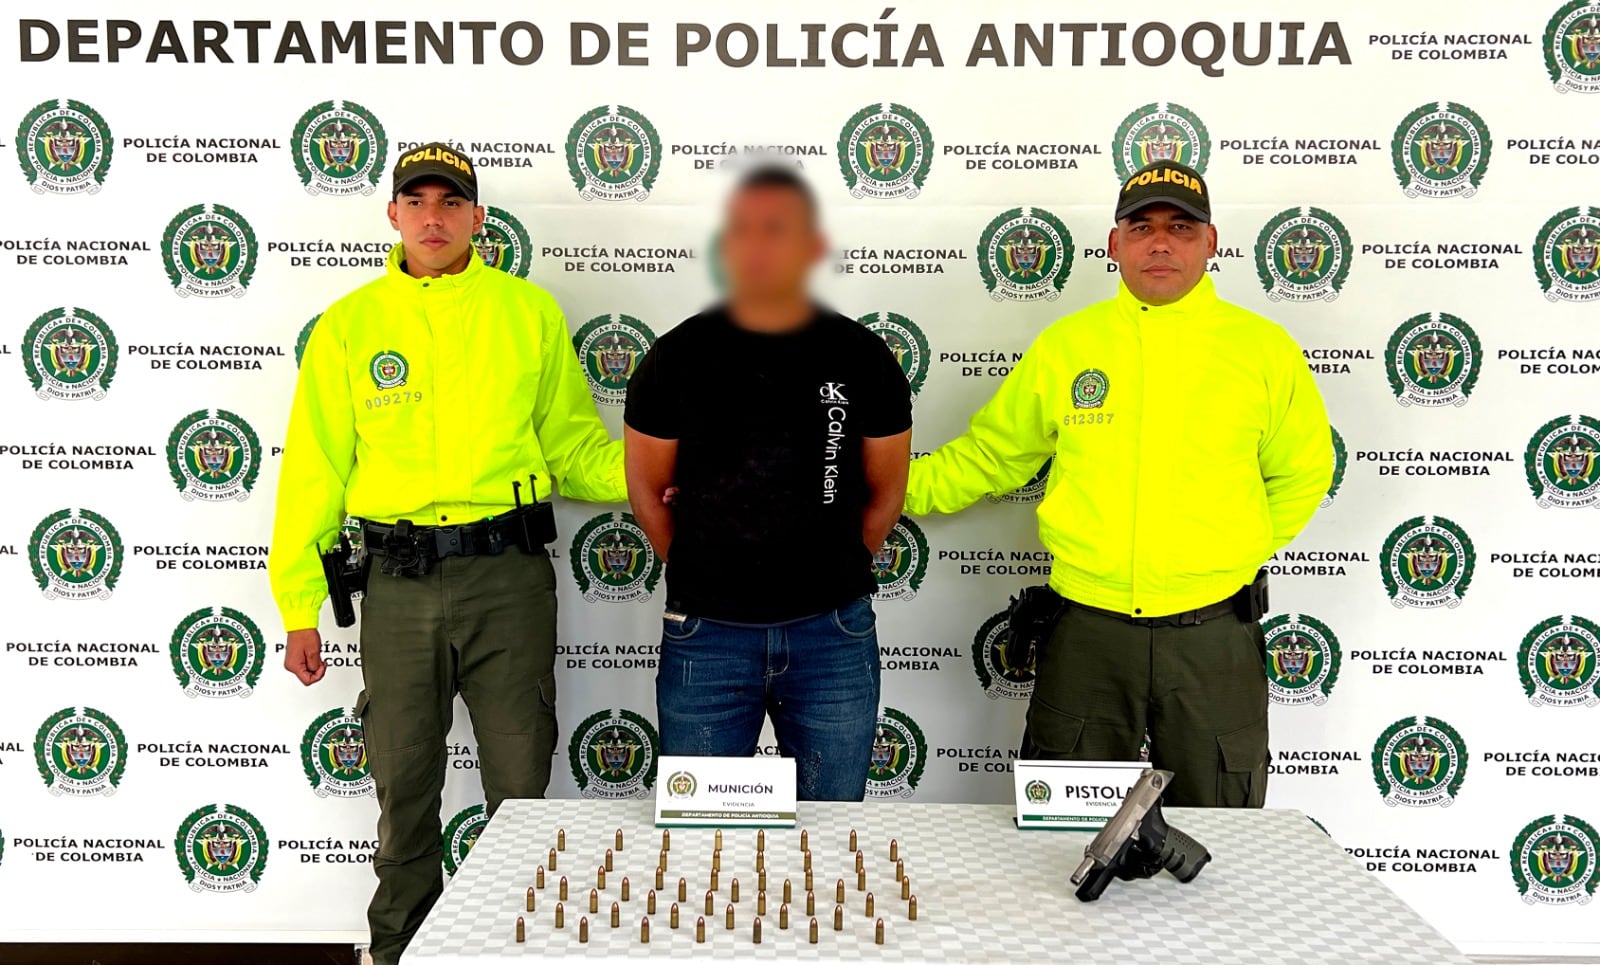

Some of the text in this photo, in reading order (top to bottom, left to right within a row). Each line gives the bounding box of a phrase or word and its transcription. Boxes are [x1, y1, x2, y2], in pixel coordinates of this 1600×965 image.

[20, 8, 1351, 77] DEPARTAMENTO DE POLICÍA ANTIOQUIA
[1369, 32, 1532, 45] POLICÍA NACIONAL
[1392, 49, 1507, 60] DE COLOMBIA
[77, 114, 101, 153] COLOMBIA
[124, 135, 280, 148] POLICÍA NACIONAL
[1221, 137, 1381, 150] POLICÍA NACIONAL
[1507, 136, 1575, 149] POLICÍA
[471, 143, 556, 154] NACIONAL
[672, 142, 736, 155] POLICÍA
[944, 142, 1101, 155] POLICÍA NACIONAL
[147, 153, 258, 163] DE COLOMBIA
[474, 157, 533, 167] LOMBIA
[1243, 155, 1357, 164] DE COLOMBIA
[1530, 154, 1599, 164] DE COLO
[695, 160, 714, 169] DE
[966, 159, 1078, 169] DE COLOMBIA
[66, 161, 98, 183] NACIONAL
[41, 181, 60, 192] DIOS
[66, 181, 91, 192] PATRIA
[67, 241, 150, 251] NACIONAL
[268, 240, 393, 253] POLICÍA NACIO
[1362, 241, 1522, 254] POLICÍA NACIONAL
[542, 245, 697, 258] POLICÍA NACIONAL
[884, 249, 967, 259] NACIONAL
[17, 255, 128, 265] DE COLOMBIA
[291, 257, 386, 267] DE COLOMB
[1385, 259, 1499, 268] DE COLOMBIA
[565, 262, 675, 272] DE COLOMBIA
[860, 264, 944, 273] COLOMBIA
[129, 343, 285, 356] POLICÍA NACIONAL
[1448, 327, 1470, 366] COLOMBIA
[940, 350, 1006, 362] POLICÍA
[1302, 350, 1374, 359] ACIONAL
[1498, 347, 1566, 359] POLICÍA
[151, 360, 262, 370] DE COLOMBIA
[1521, 364, 1600, 374] DE COLOM
[962, 367, 982, 376] DE
[1433, 372, 1467, 396] NACIONAL
[1408, 393, 1426, 404] DIOS
[1433, 393, 1458, 405] PATRIA
[1064, 413, 1115, 426] 612387
[0, 443, 156, 455] POLICÍA NACIONAL
[822, 406, 847, 504] Calvin Klein
[1357, 448, 1514, 461] POLICÍA NACIONAL
[23, 460, 133, 469] DE COLOMBIA
[1379, 466, 1490, 475] DE COLOMBIA
[134, 543, 268, 555] POLICÍA NACION
[939, 549, 1053, 561] POLICÍA NACI
[1285, 552, 1370, 561] NACIONAL
[1491, 551, 1558, 563] POLICÍA
[157, 560, 267, 569] DE COLOMBIA
[961, 565, 1051, 575] DE COLOMB
[1513, 568, 1533, 577] DE
[7, 640, 160, 653] POLICÍA NACIONAL
[555, 642, 661, 655] OLICÍA NACIO
[880, 647, 962, 657] NACIONAL
[1351, 648, 1507, 661] POLICÍA NACIONAL
[29, 657, 137, 666] DE COLOMBIA
[567, 659, 657, 669] DE COLOMB
[880, 661, 939, 670] LOMBIA
[1373, 665, 1483, 674] DE COLOMBIA
[138, 741, 290, 753] POLICÍA NACIONAL
[937, 746, 1002, 759] POLICÍA
[1279, 751, 1361, 761] NACIONAL
[1484, 750, 1550, 762] POLICÍA
[160, 758, 268, 767] DE COLOMBIA
[959, 763, 978, 772] DE
[1268, 765, 1338, 774] OLOMBIA
[1506, 767, 1598, 776] DE COLOMB
[708, 782, 773, 794] MUNICIÓN
[14, 836, 165, 848] POLICÍA NACIONAL
[279, 837, 343, 849] POLICÍA
[36, 852, 143, 862] DE COLOMBIA
[301, 854, 320, 863] DE
[1417, 849, 1500, 859] NACIONAL
[1367, 862, 1476, 872] DE COLOMBIA
